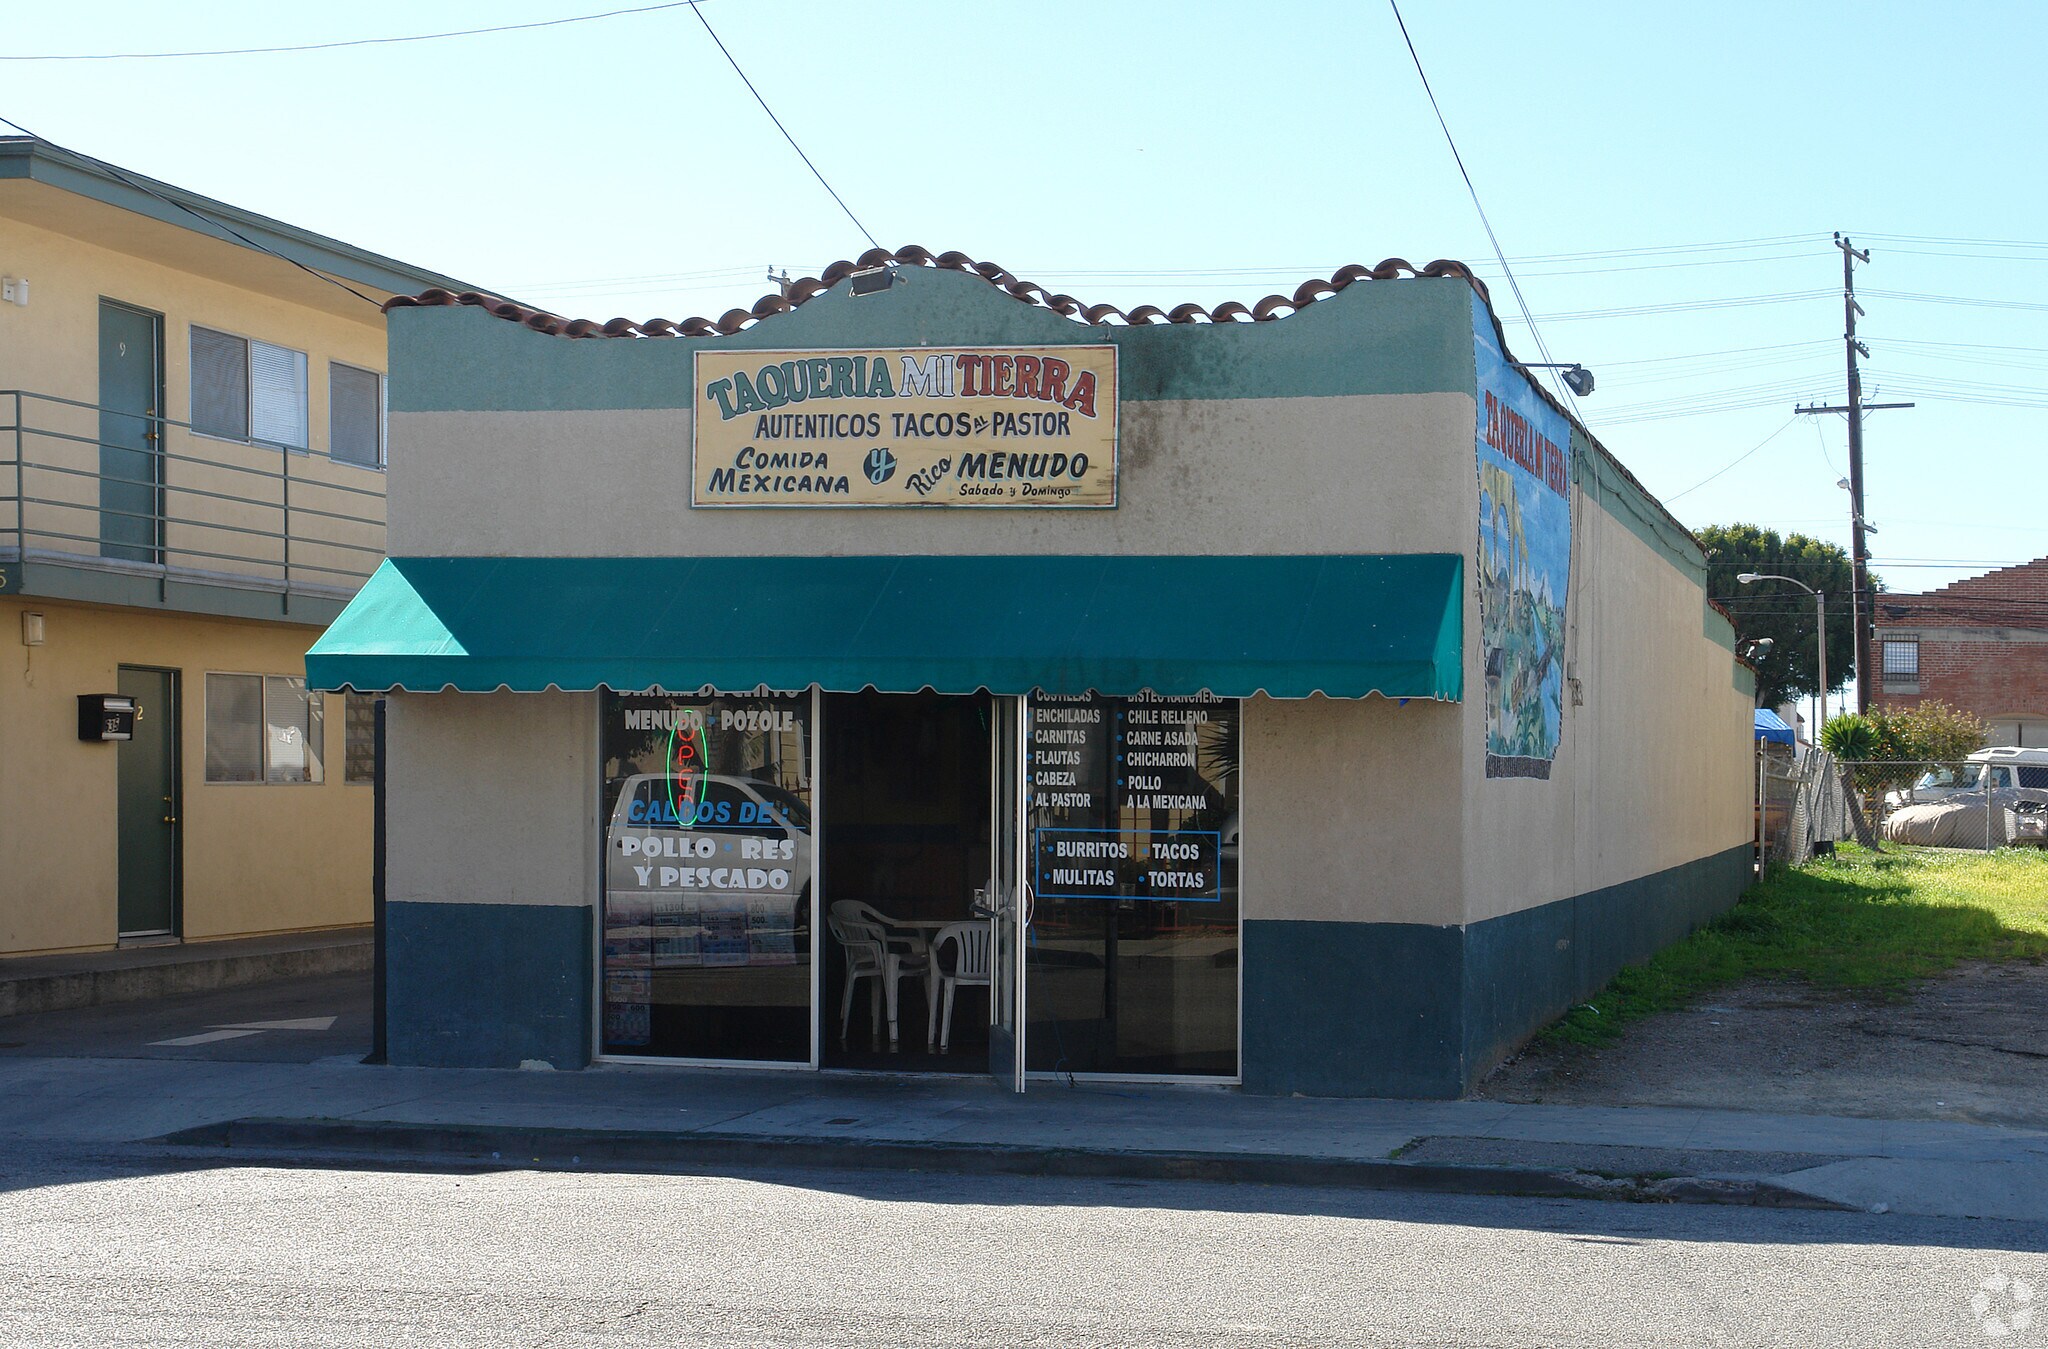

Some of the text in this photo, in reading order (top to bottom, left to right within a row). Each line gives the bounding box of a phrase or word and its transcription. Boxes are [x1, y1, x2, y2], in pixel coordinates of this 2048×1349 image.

[119, 341, 127, 357] 9
[707, 353, 1097, 421] TAQUERIA MI TIERRA
[754, 411, 1070, 439] AUTENTICOS TACOS AL PASTOR
[1485, 389, 1535, 475] TAQUERIA
[734, 446, 828, 470] COMIDA
[707, 468, 849, 493] MEXICANA
[905, 453, 1088, 496] Rico MENUDO
[958, 483, 1071, 498] Sabado y Domingo
[137, 705, 144, 720] 2
[625, 709, 794, 731] MENUDO POZOLE
[1036, 708, 1100, 723] ENCHILADAS
[1128, 709, 1208, 725] CHILE RELLENO
[1035, 729, 1086, 744] CARNITAS
[1126, 731, 1199, 746] CARNE ASADA
[1035, 751, 1080, 765] FLAUTAS
[1127, 751, 1195, 767] CHICHARRON
[1035, 771, 1076, 786] CABEZA
[1128, 775, 1162, 791] POLLO
[1035, 792, 1091, 808] AL PASTOR
[1126, 794, 1207, 810] A LA MEXICANA
[628, 800, 731, 822] CALDOS
[621, 836, 795, 860] POLLO RES
[1056, 841, 1200, 860] BURRITOS TACOS
[633, 866, 789, 890] Y PESCADO
[1053, 869, 1204, 888] MULITAS TORTAS
